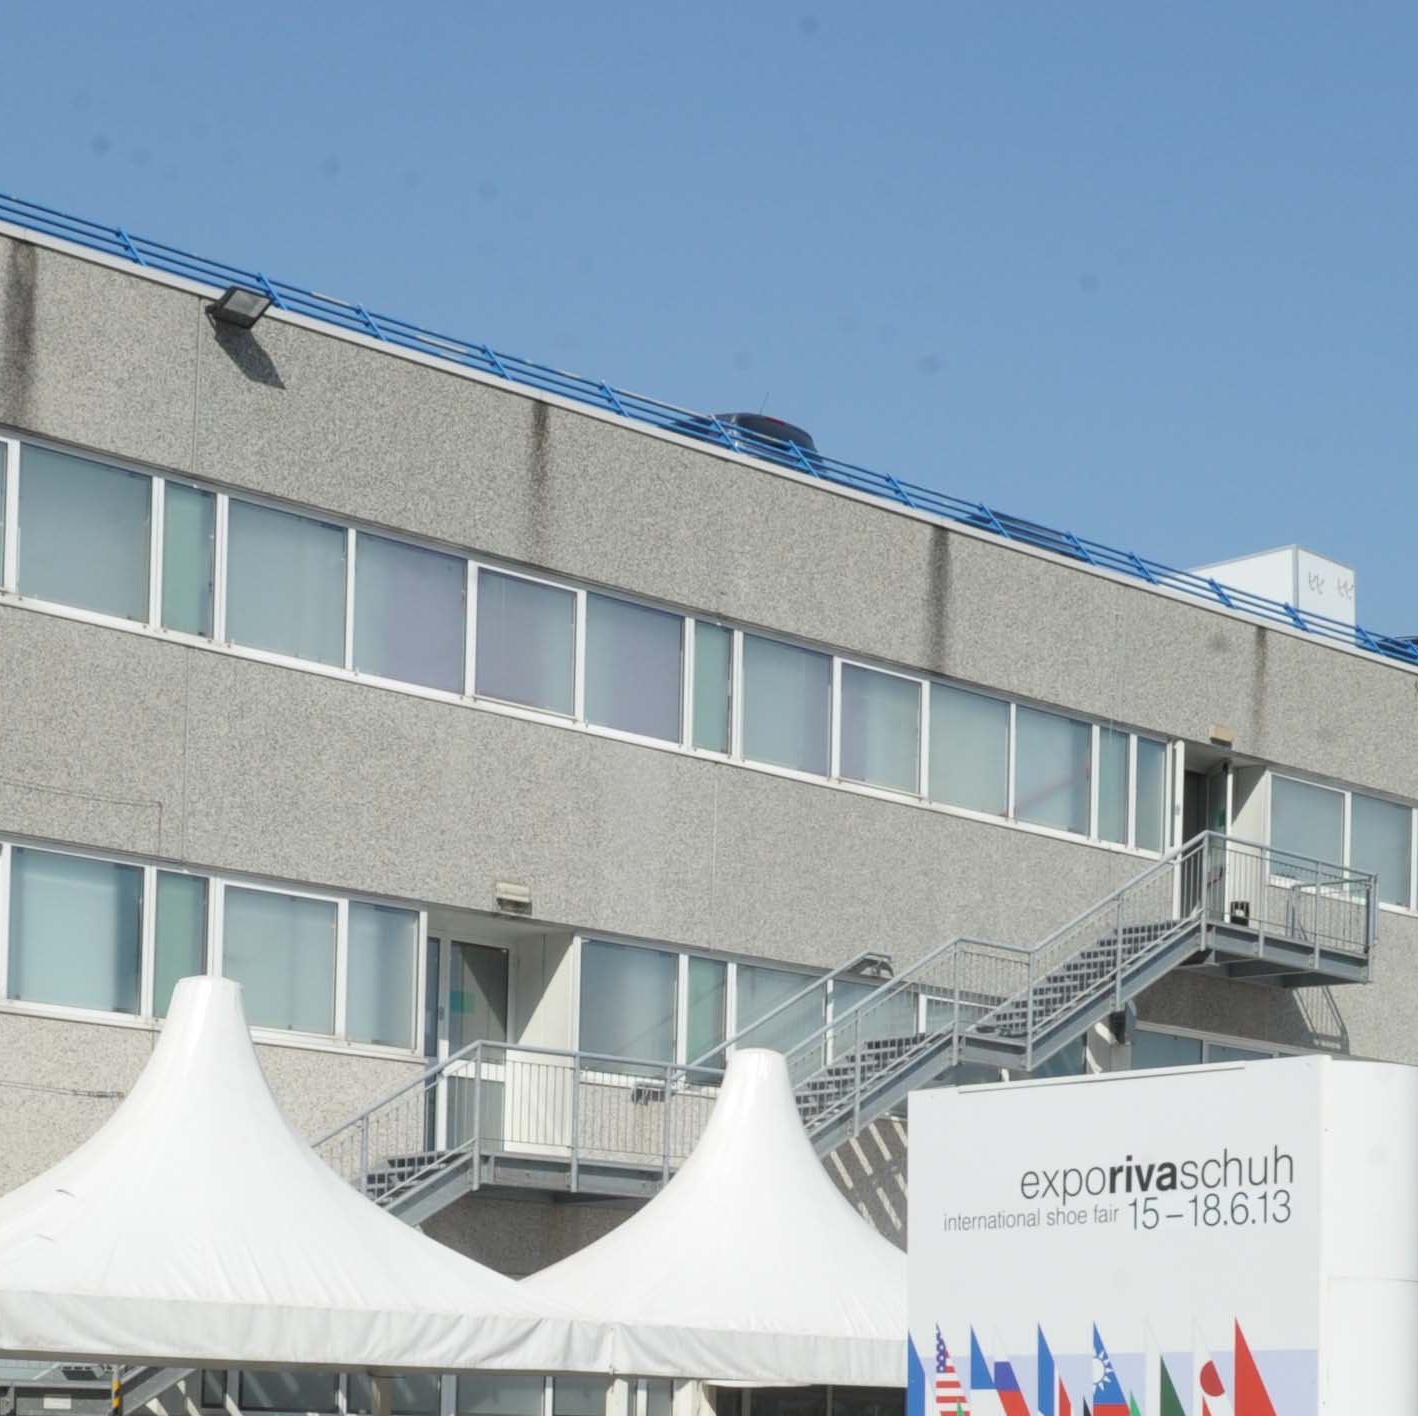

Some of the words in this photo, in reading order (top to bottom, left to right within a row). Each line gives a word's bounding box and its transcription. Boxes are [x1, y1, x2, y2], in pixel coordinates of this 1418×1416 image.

[1021, 1145, 1294, 1206] exporivaschuh
[944, 1207, 1040, 1232] international
[1046, 1205, 1087, 1227] shoe
[1093, 1203, 1119, 1224] fair
